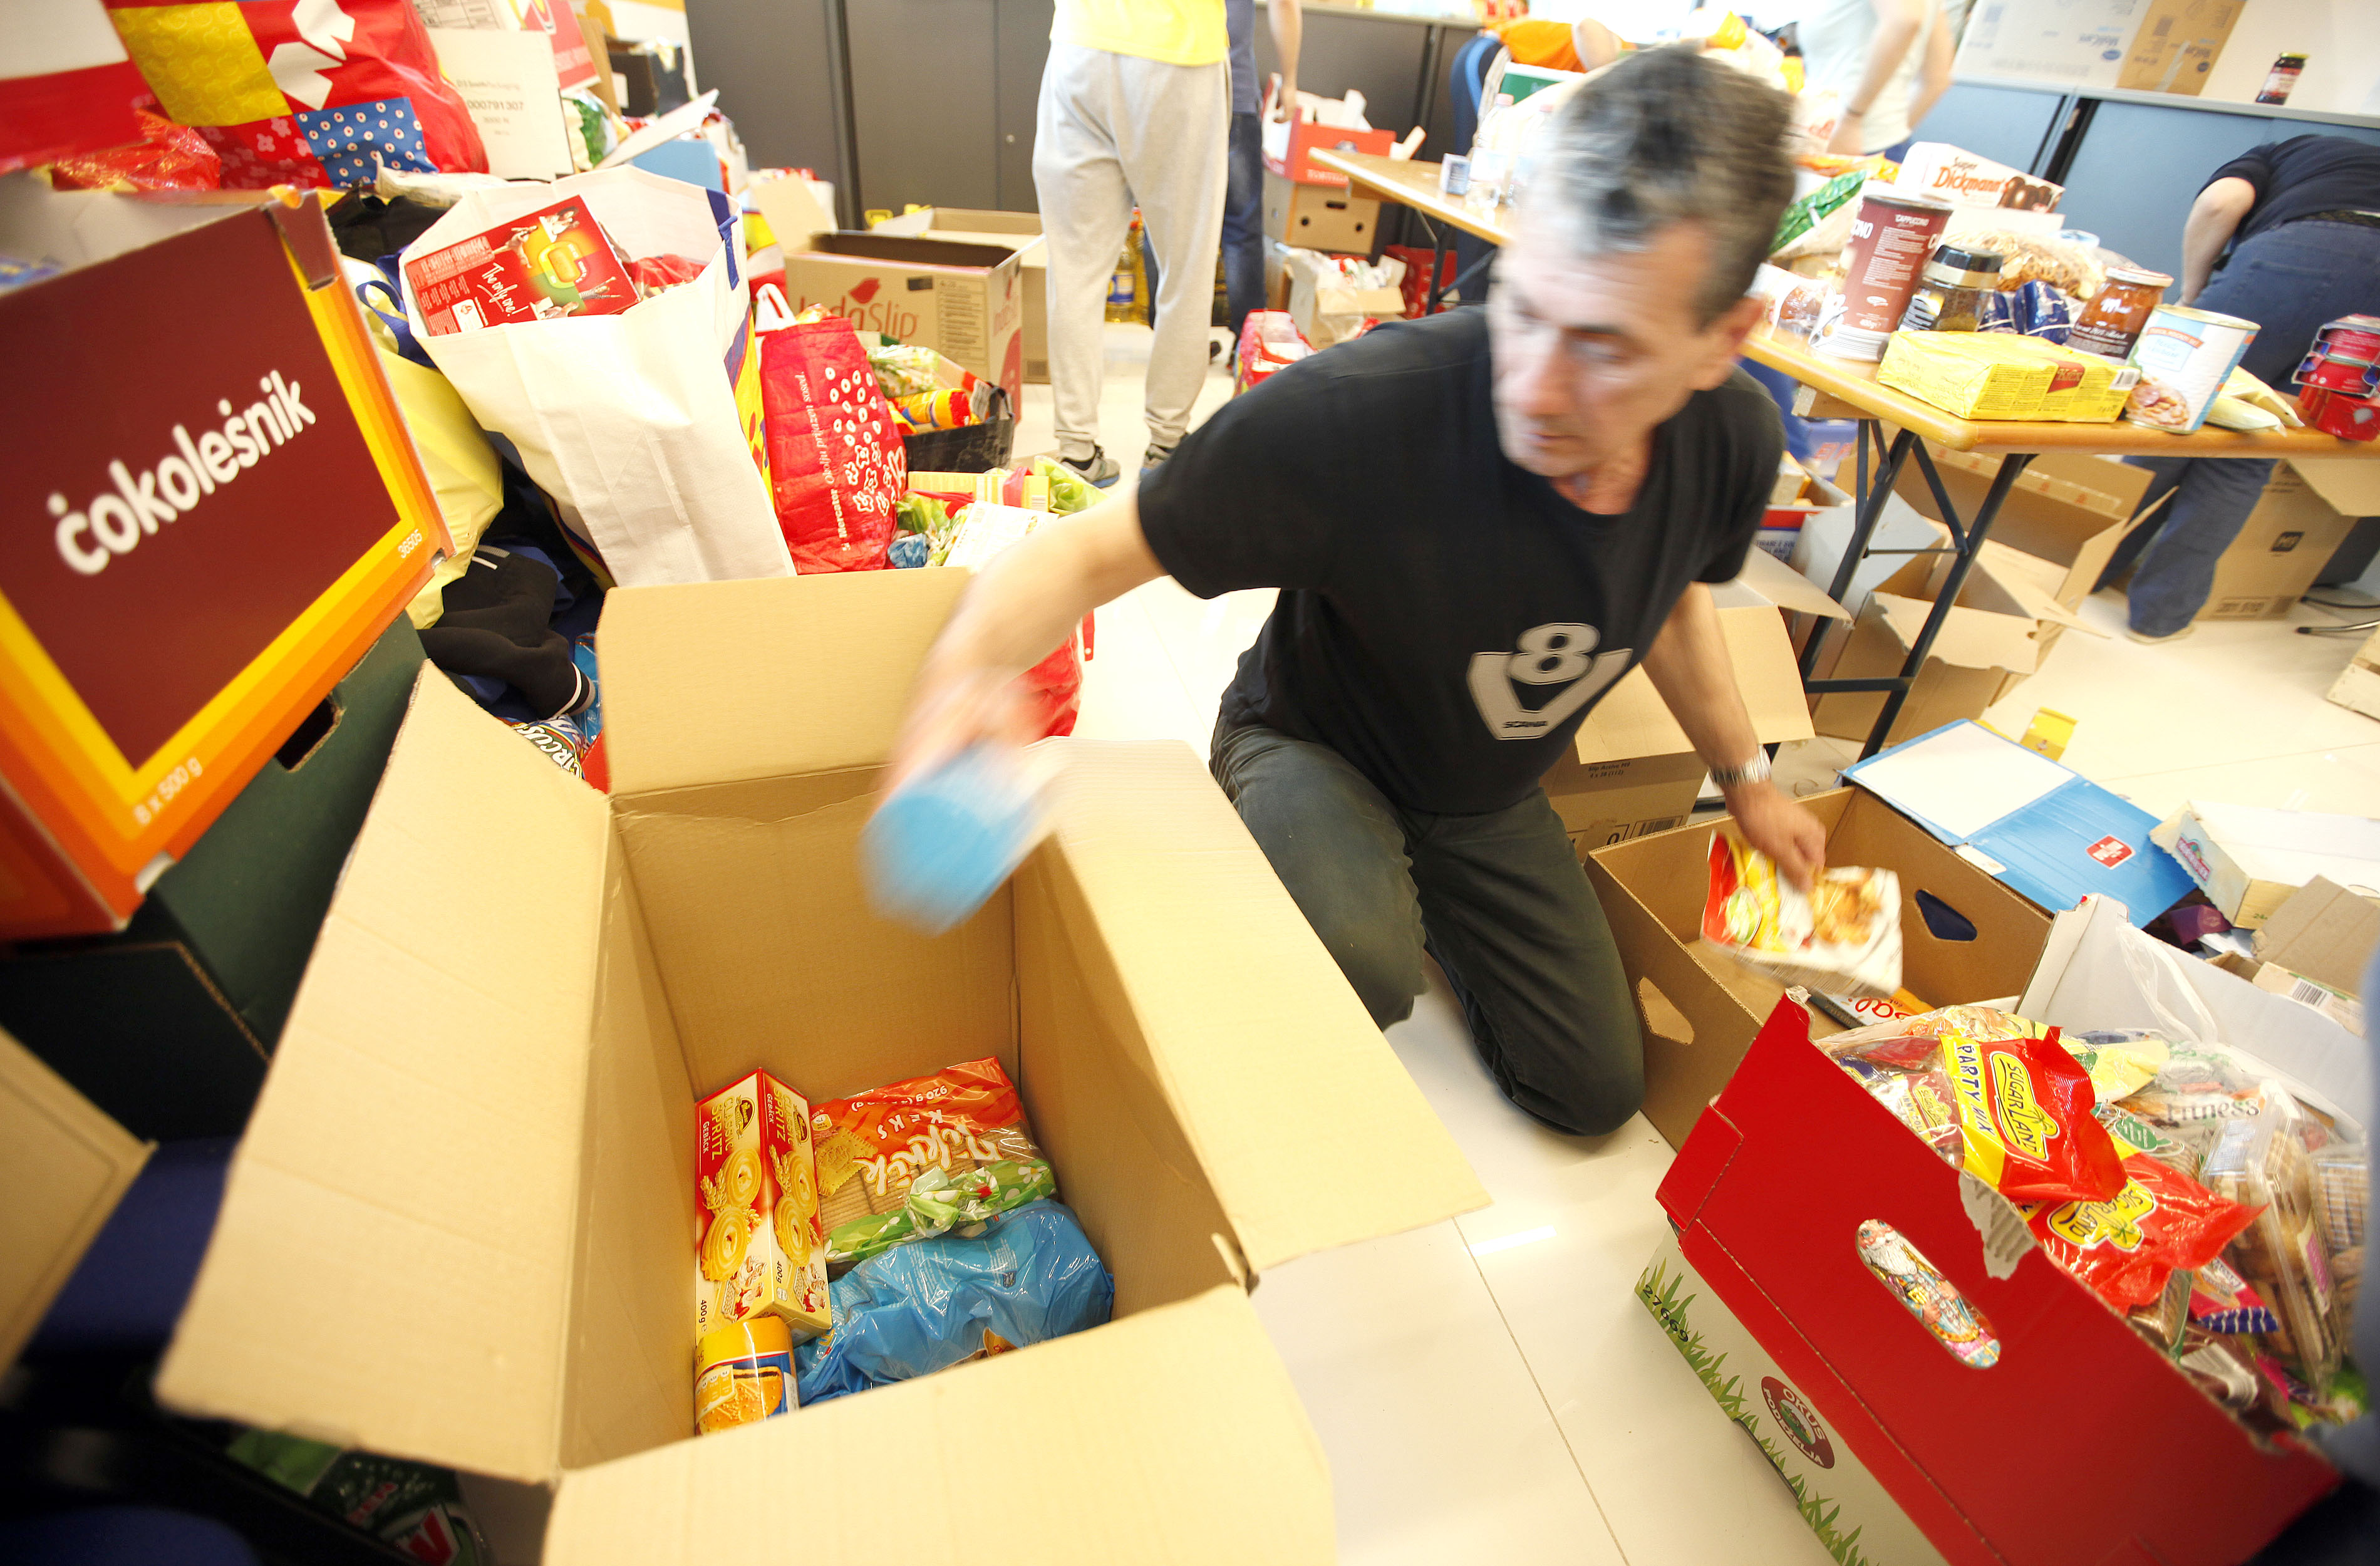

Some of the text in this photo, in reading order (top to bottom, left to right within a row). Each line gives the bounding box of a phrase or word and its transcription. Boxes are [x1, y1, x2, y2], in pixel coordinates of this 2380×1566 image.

[482, 262, 529, 317] The only one!
[806, 405, 827, 449] prijazen
[819, 450, 835, 484] Okolju
[830, 489, 847, 538] Mercator
[398, 529, 423, 559] 36505
[767, 1092, 775, 1124] GEBÄCK
[773, 1087, 786, 1143] SPRITZ
[926, 1085, 948, 1100] 920
[1957, 1045, 1997, 1137] PARTY MIX
[2007, 1063, 2038, 1153] SUGARLAND
[703, 1121, 711, 1154] GEBÄCK
[711, 1102, 723, 1161] SPRITZ
[724, 1097, 734, 1152] CLASSIC
[783, 1094, 795, 1146] CLASSIC
[877, 1109, 944, 1139] KEKS
[1643, 1284, 1689, 1342] 27669
[1783, 1388, 1826, 1439] OKUS
